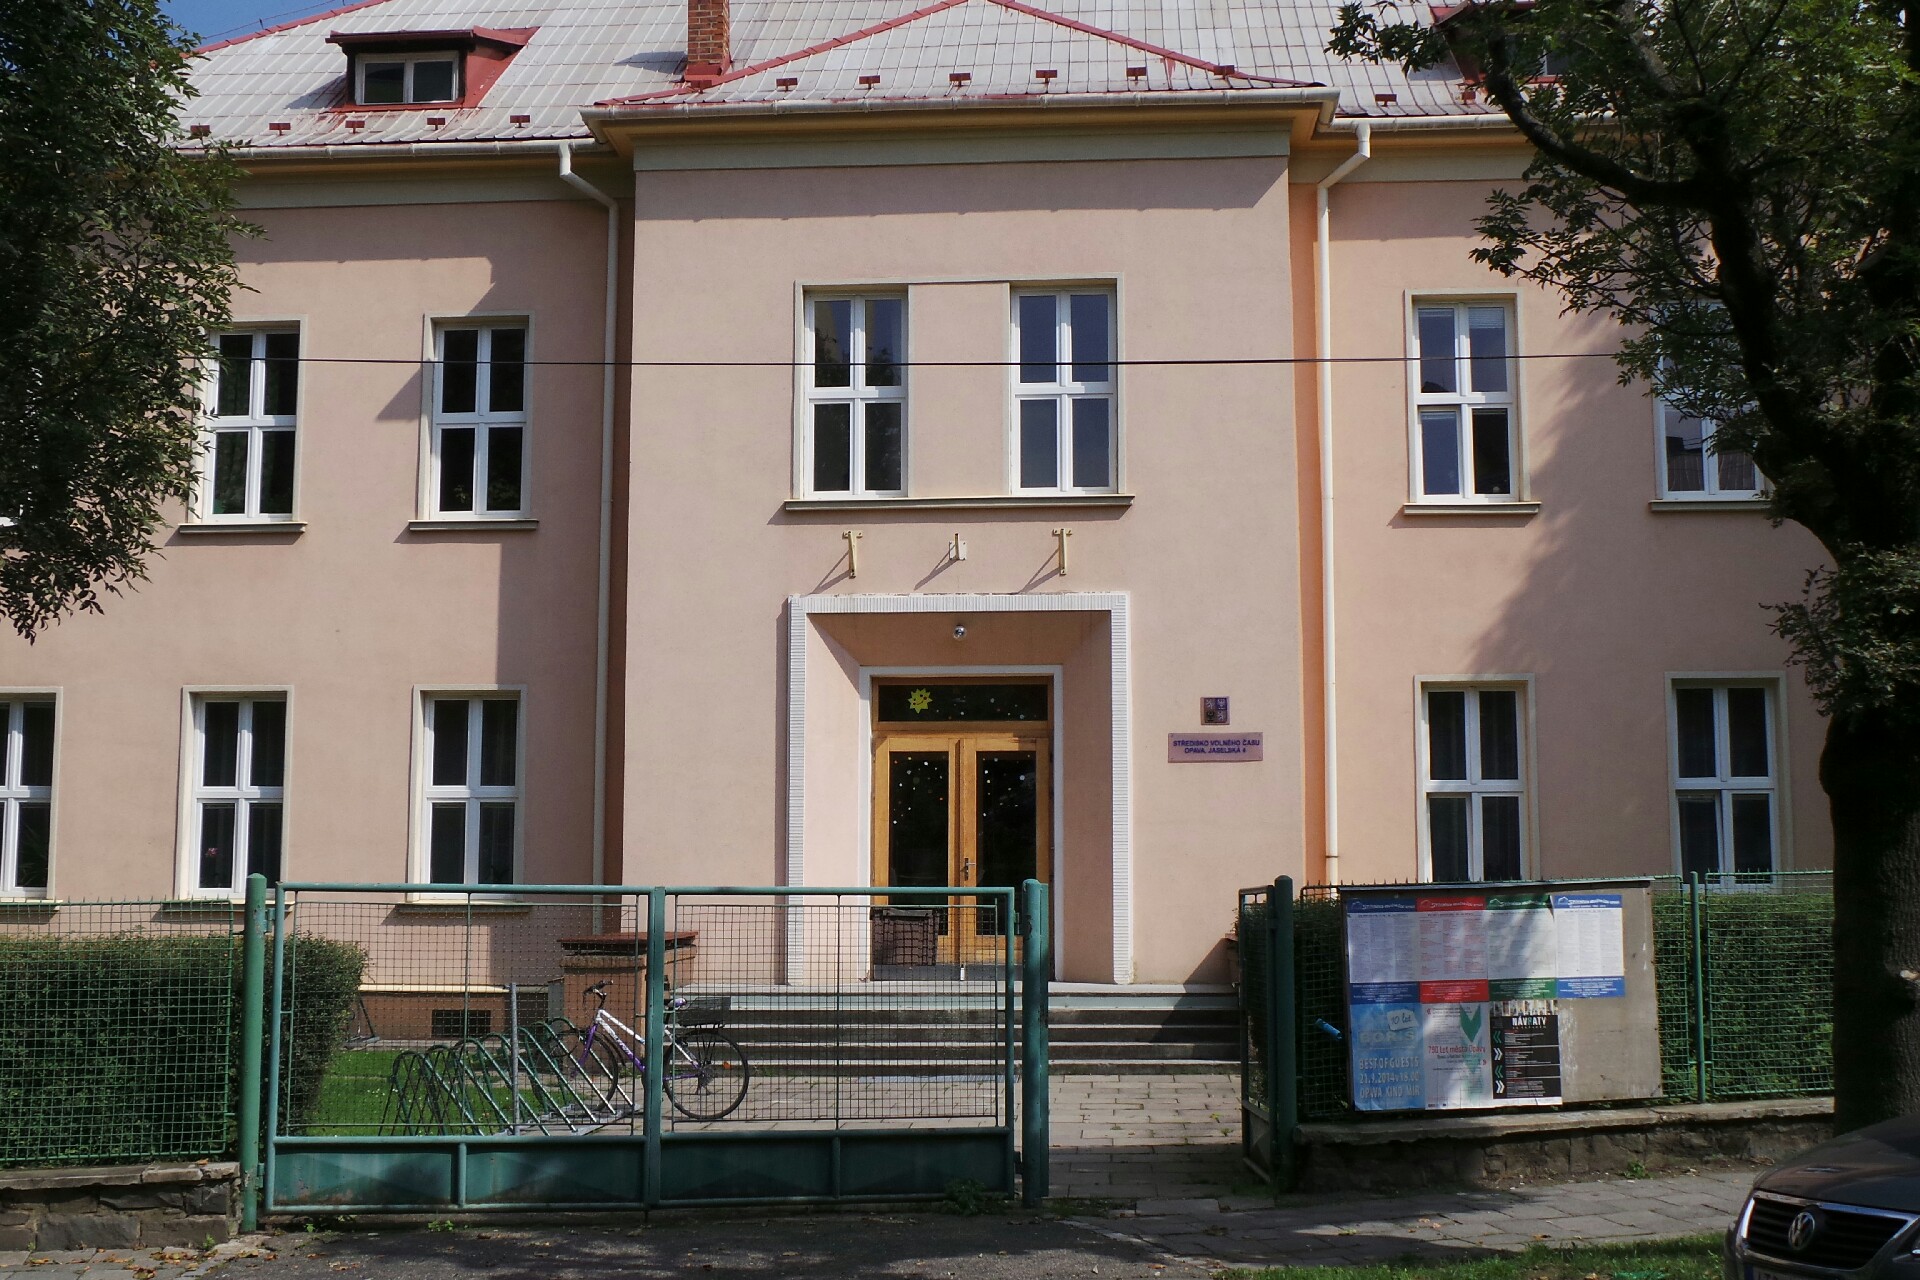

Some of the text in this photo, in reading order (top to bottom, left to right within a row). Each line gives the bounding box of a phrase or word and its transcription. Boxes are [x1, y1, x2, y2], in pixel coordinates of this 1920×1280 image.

[1173, 738, 1260, 747] STŘEDISKO VOLNÉHO ČASU
[1512, 1015, 1547, 1026] NÁVRATY
